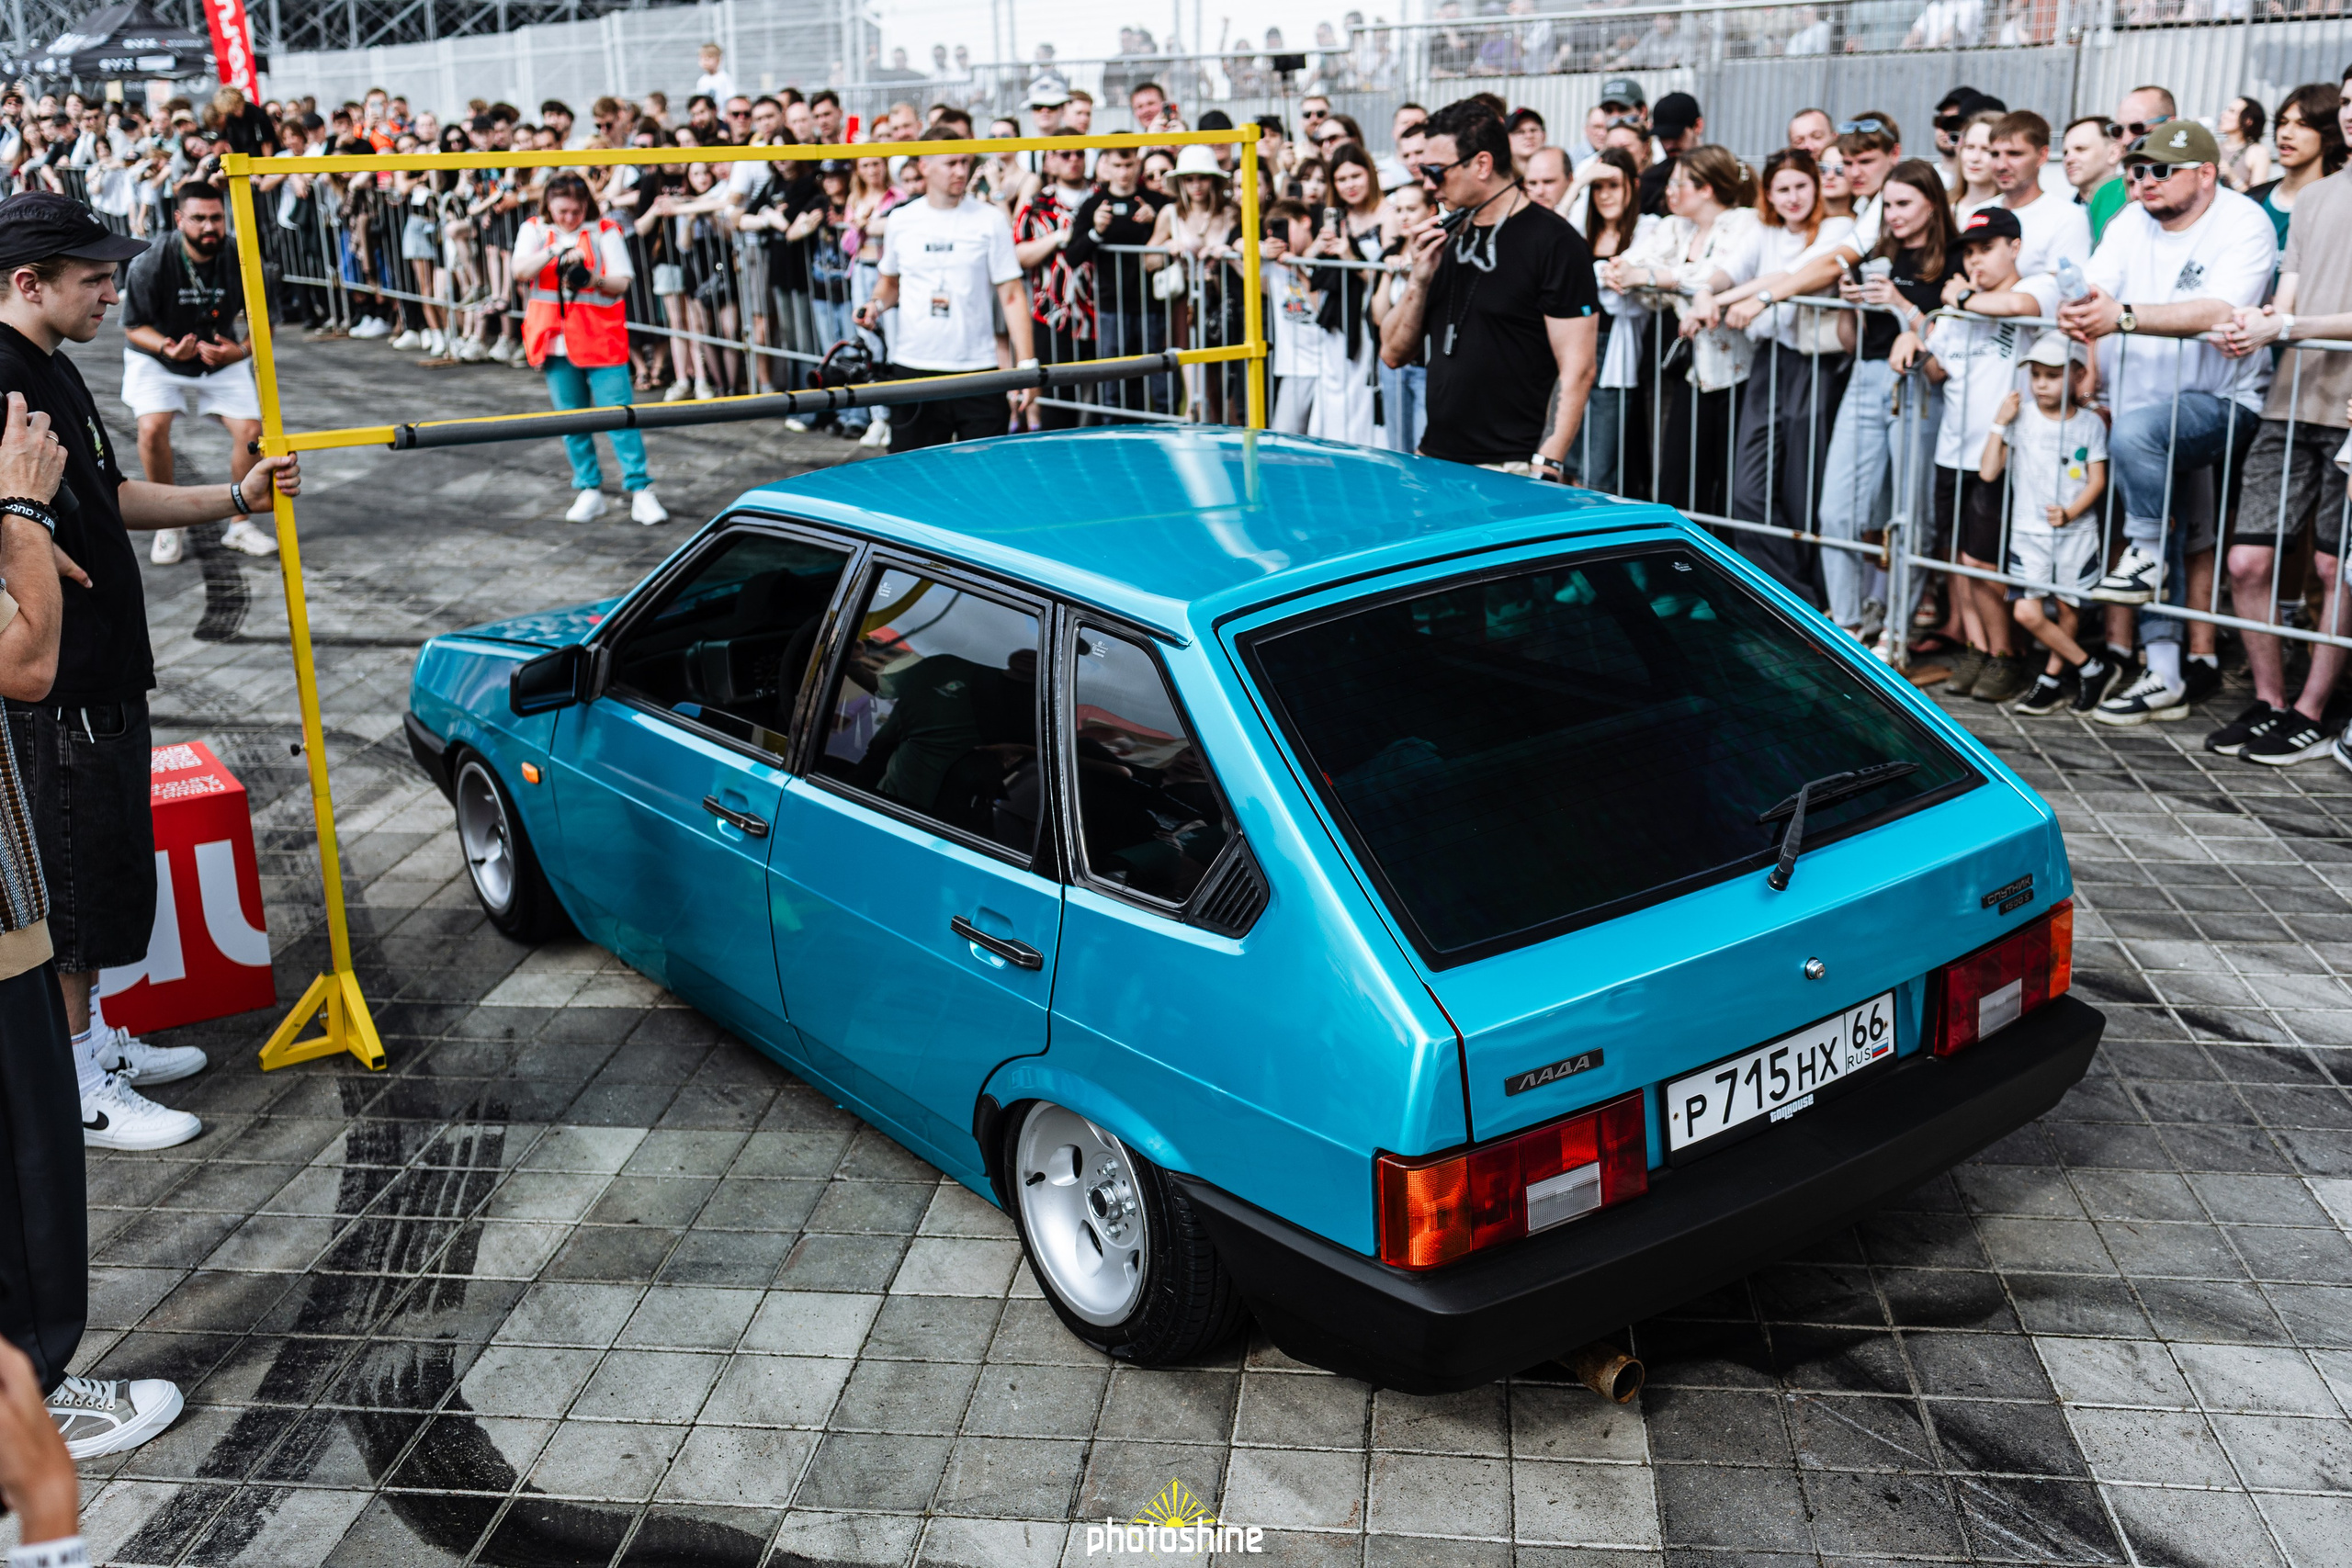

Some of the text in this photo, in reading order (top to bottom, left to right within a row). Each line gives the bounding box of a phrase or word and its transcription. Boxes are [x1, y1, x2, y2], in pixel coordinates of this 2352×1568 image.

[1987, 876, 2031, 905] СПУТНИК
[2005, 897, 2024, 910] 1500
[1851, 1002, 1884, 1049] 66
[1518, 1055, 1590, 1090] ЛАДА
[1847, 1047, 1871, 1069] RUS
